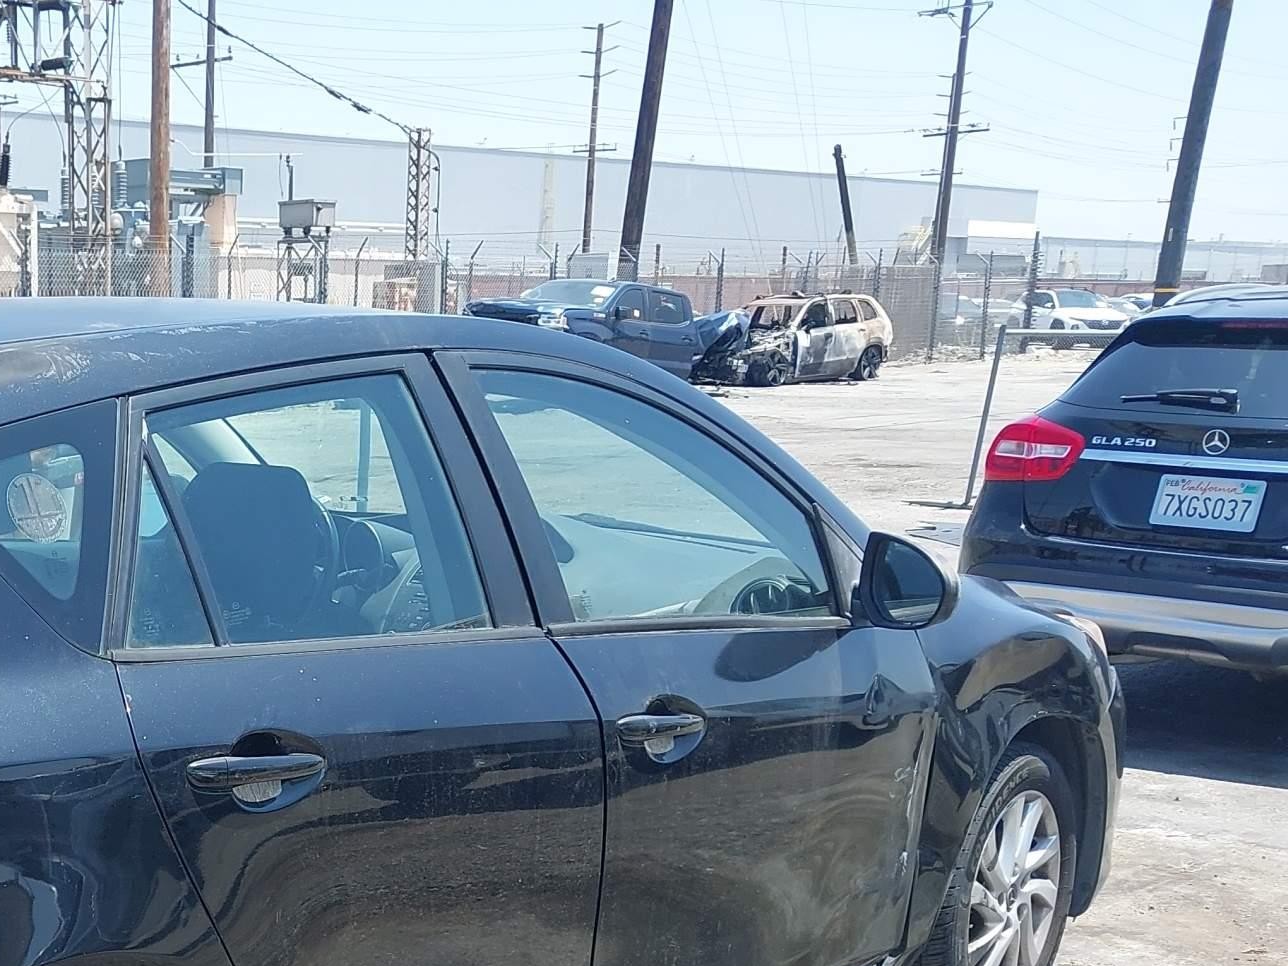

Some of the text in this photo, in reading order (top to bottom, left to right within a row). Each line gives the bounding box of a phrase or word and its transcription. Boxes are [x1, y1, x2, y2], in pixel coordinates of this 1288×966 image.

[1092, 435, 1157, 447] GLA 250
[1181, 479, 1242, 495] California
[1163, 493, 1252, 522] 7XGS037
